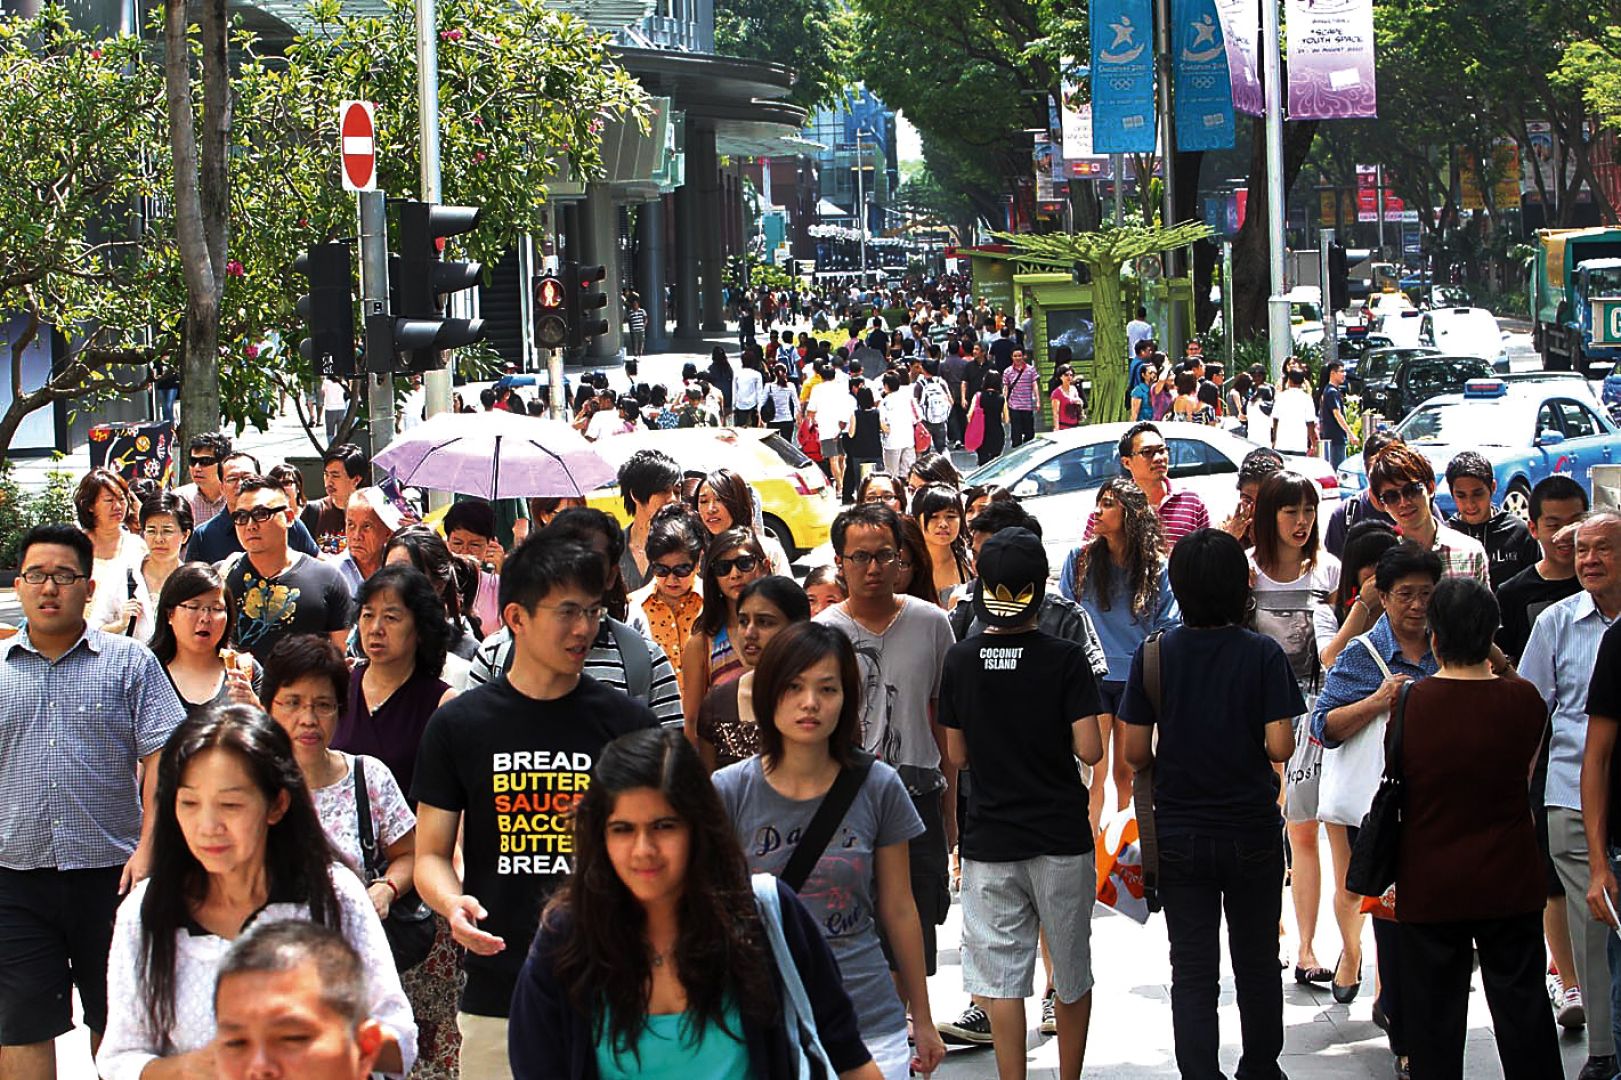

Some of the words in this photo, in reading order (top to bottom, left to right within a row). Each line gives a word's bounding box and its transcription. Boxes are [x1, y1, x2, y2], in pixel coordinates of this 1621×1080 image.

[979, 647, 1024, 659] COCONUT
[984, 658, 1018, 670] ISLAND
[493, 751, 592, 772] BREAD
[493, 772, 591, 793] BUTTER
[497, 814, 576, 833] BACO
[500, 834, 576, 853] BUTTE
[497, 855, 577, 875] BREA
